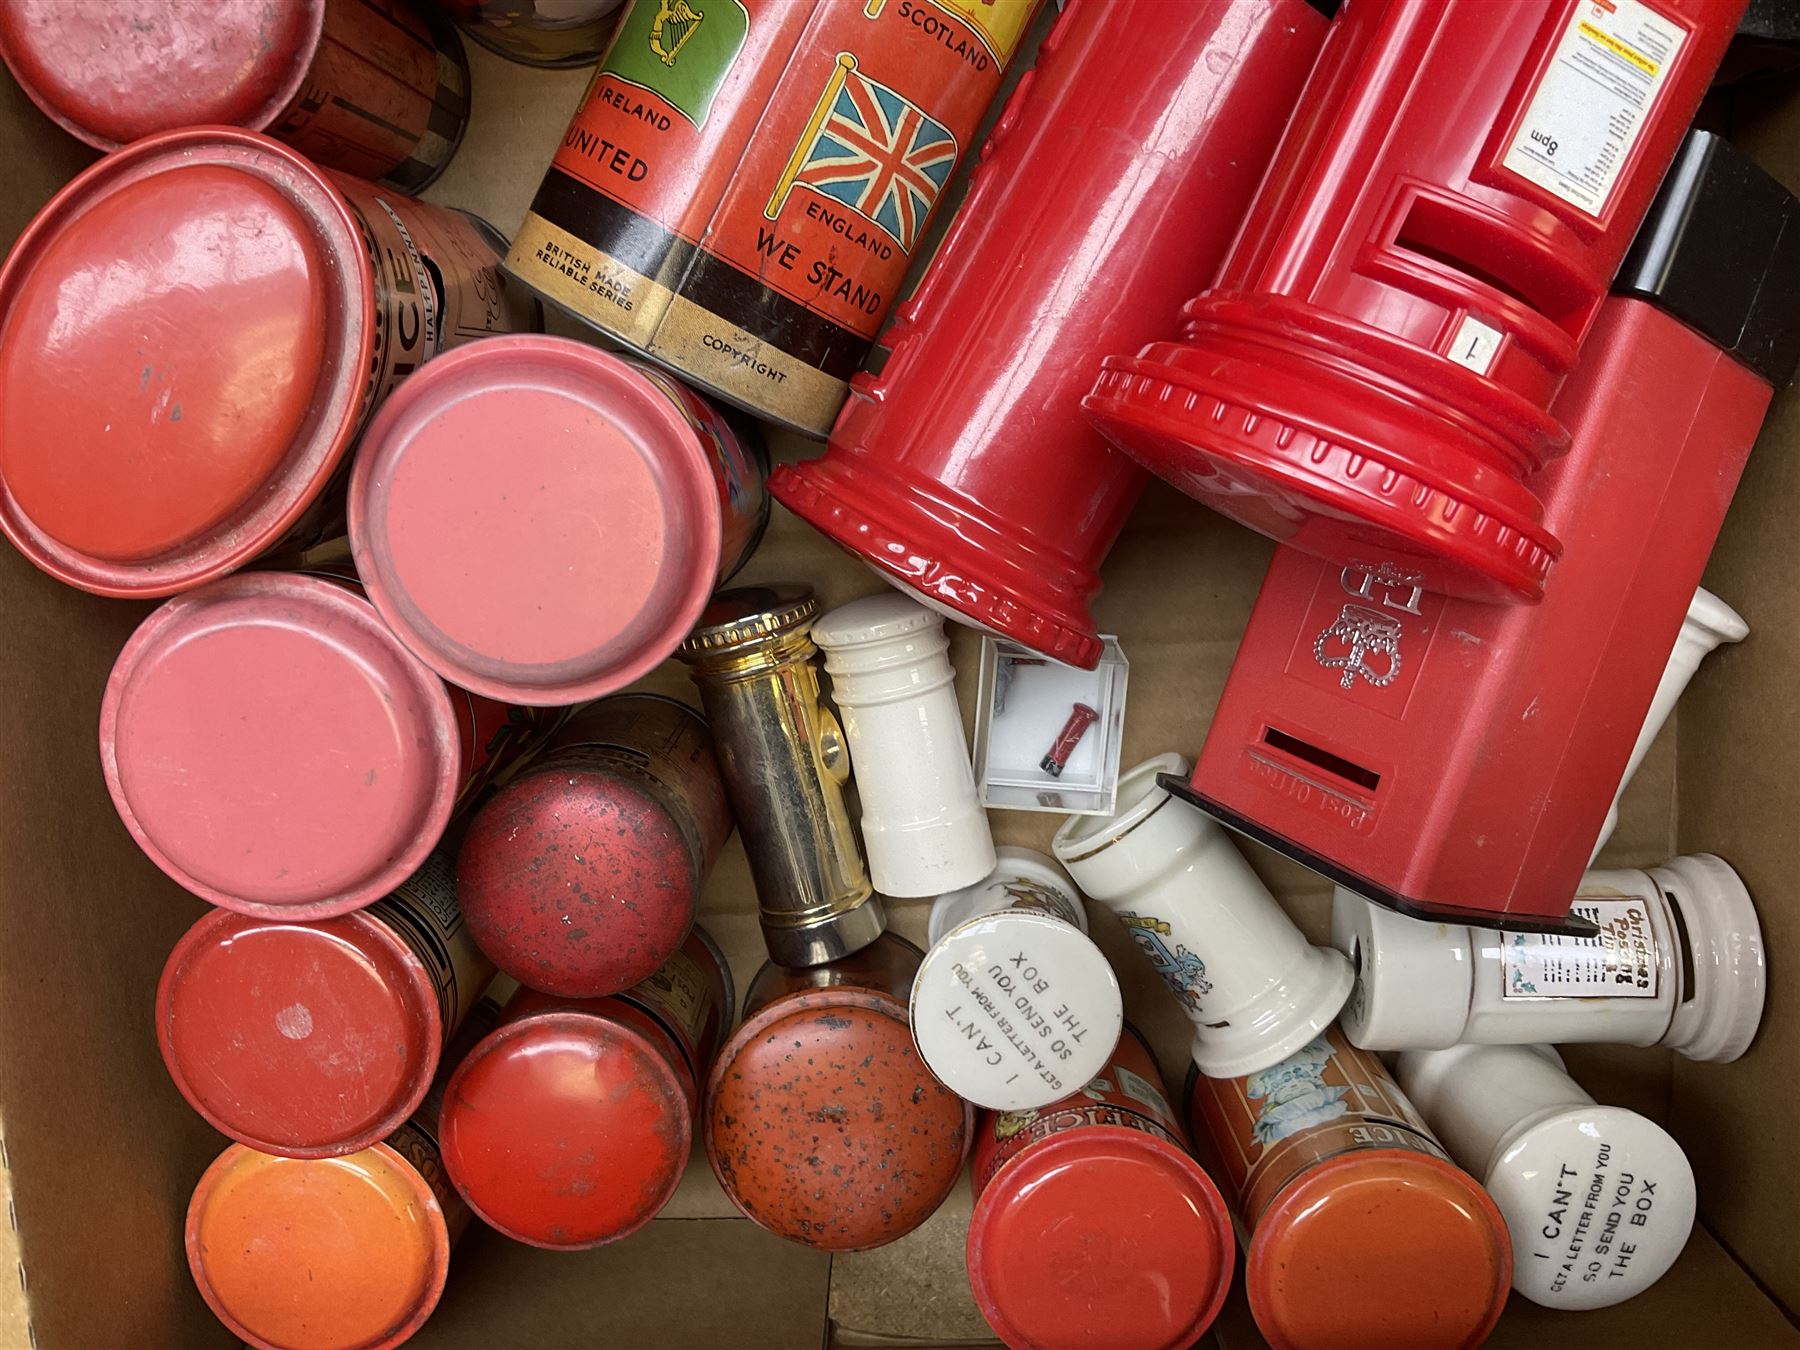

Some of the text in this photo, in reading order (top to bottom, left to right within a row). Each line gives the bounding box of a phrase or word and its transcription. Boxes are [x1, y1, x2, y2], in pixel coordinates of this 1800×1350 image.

[898, 2, 988, 71] SCOTLAND
[597, 85, 672, 131] IRELAND
[1530, 129, 1559, 156] 8pm
[566, 129, 649, 182] UNITED
[806, 201, 892, 261] ENGLAND
[535, 249, 634, 312] RELIABLE SERIES
[545, 241, 632, 297] BRITISH MADE
[757, 227, 881, 315] WE STAND
[702, 334, 787, 384] COPYRIGHT
[1465, 337, 1479, 359] 1
[1249, 760, 1368, 831] Post Office
[1602, 922, 1618, 974] Tims
[1614, 917, 1634, 985] Posng
[951, 963, 1063, 1090] GET A LETTER FROM YOU
[988, 965, 1073, 1061] SO SEND YOU
[1009, 951, 1088, 1043] THE BOX
[945, 1006, 1019, 1085] I CAN'T
[1542, 1163, 1578, 1239] CAN'T
[1550, 1143, 1612, 1292] GET A LETTER FROM YOU
[1583, 1172, 1634, 1282] SO SEND YOU
[1609, 1180, 1657, 1279] THE BOX
